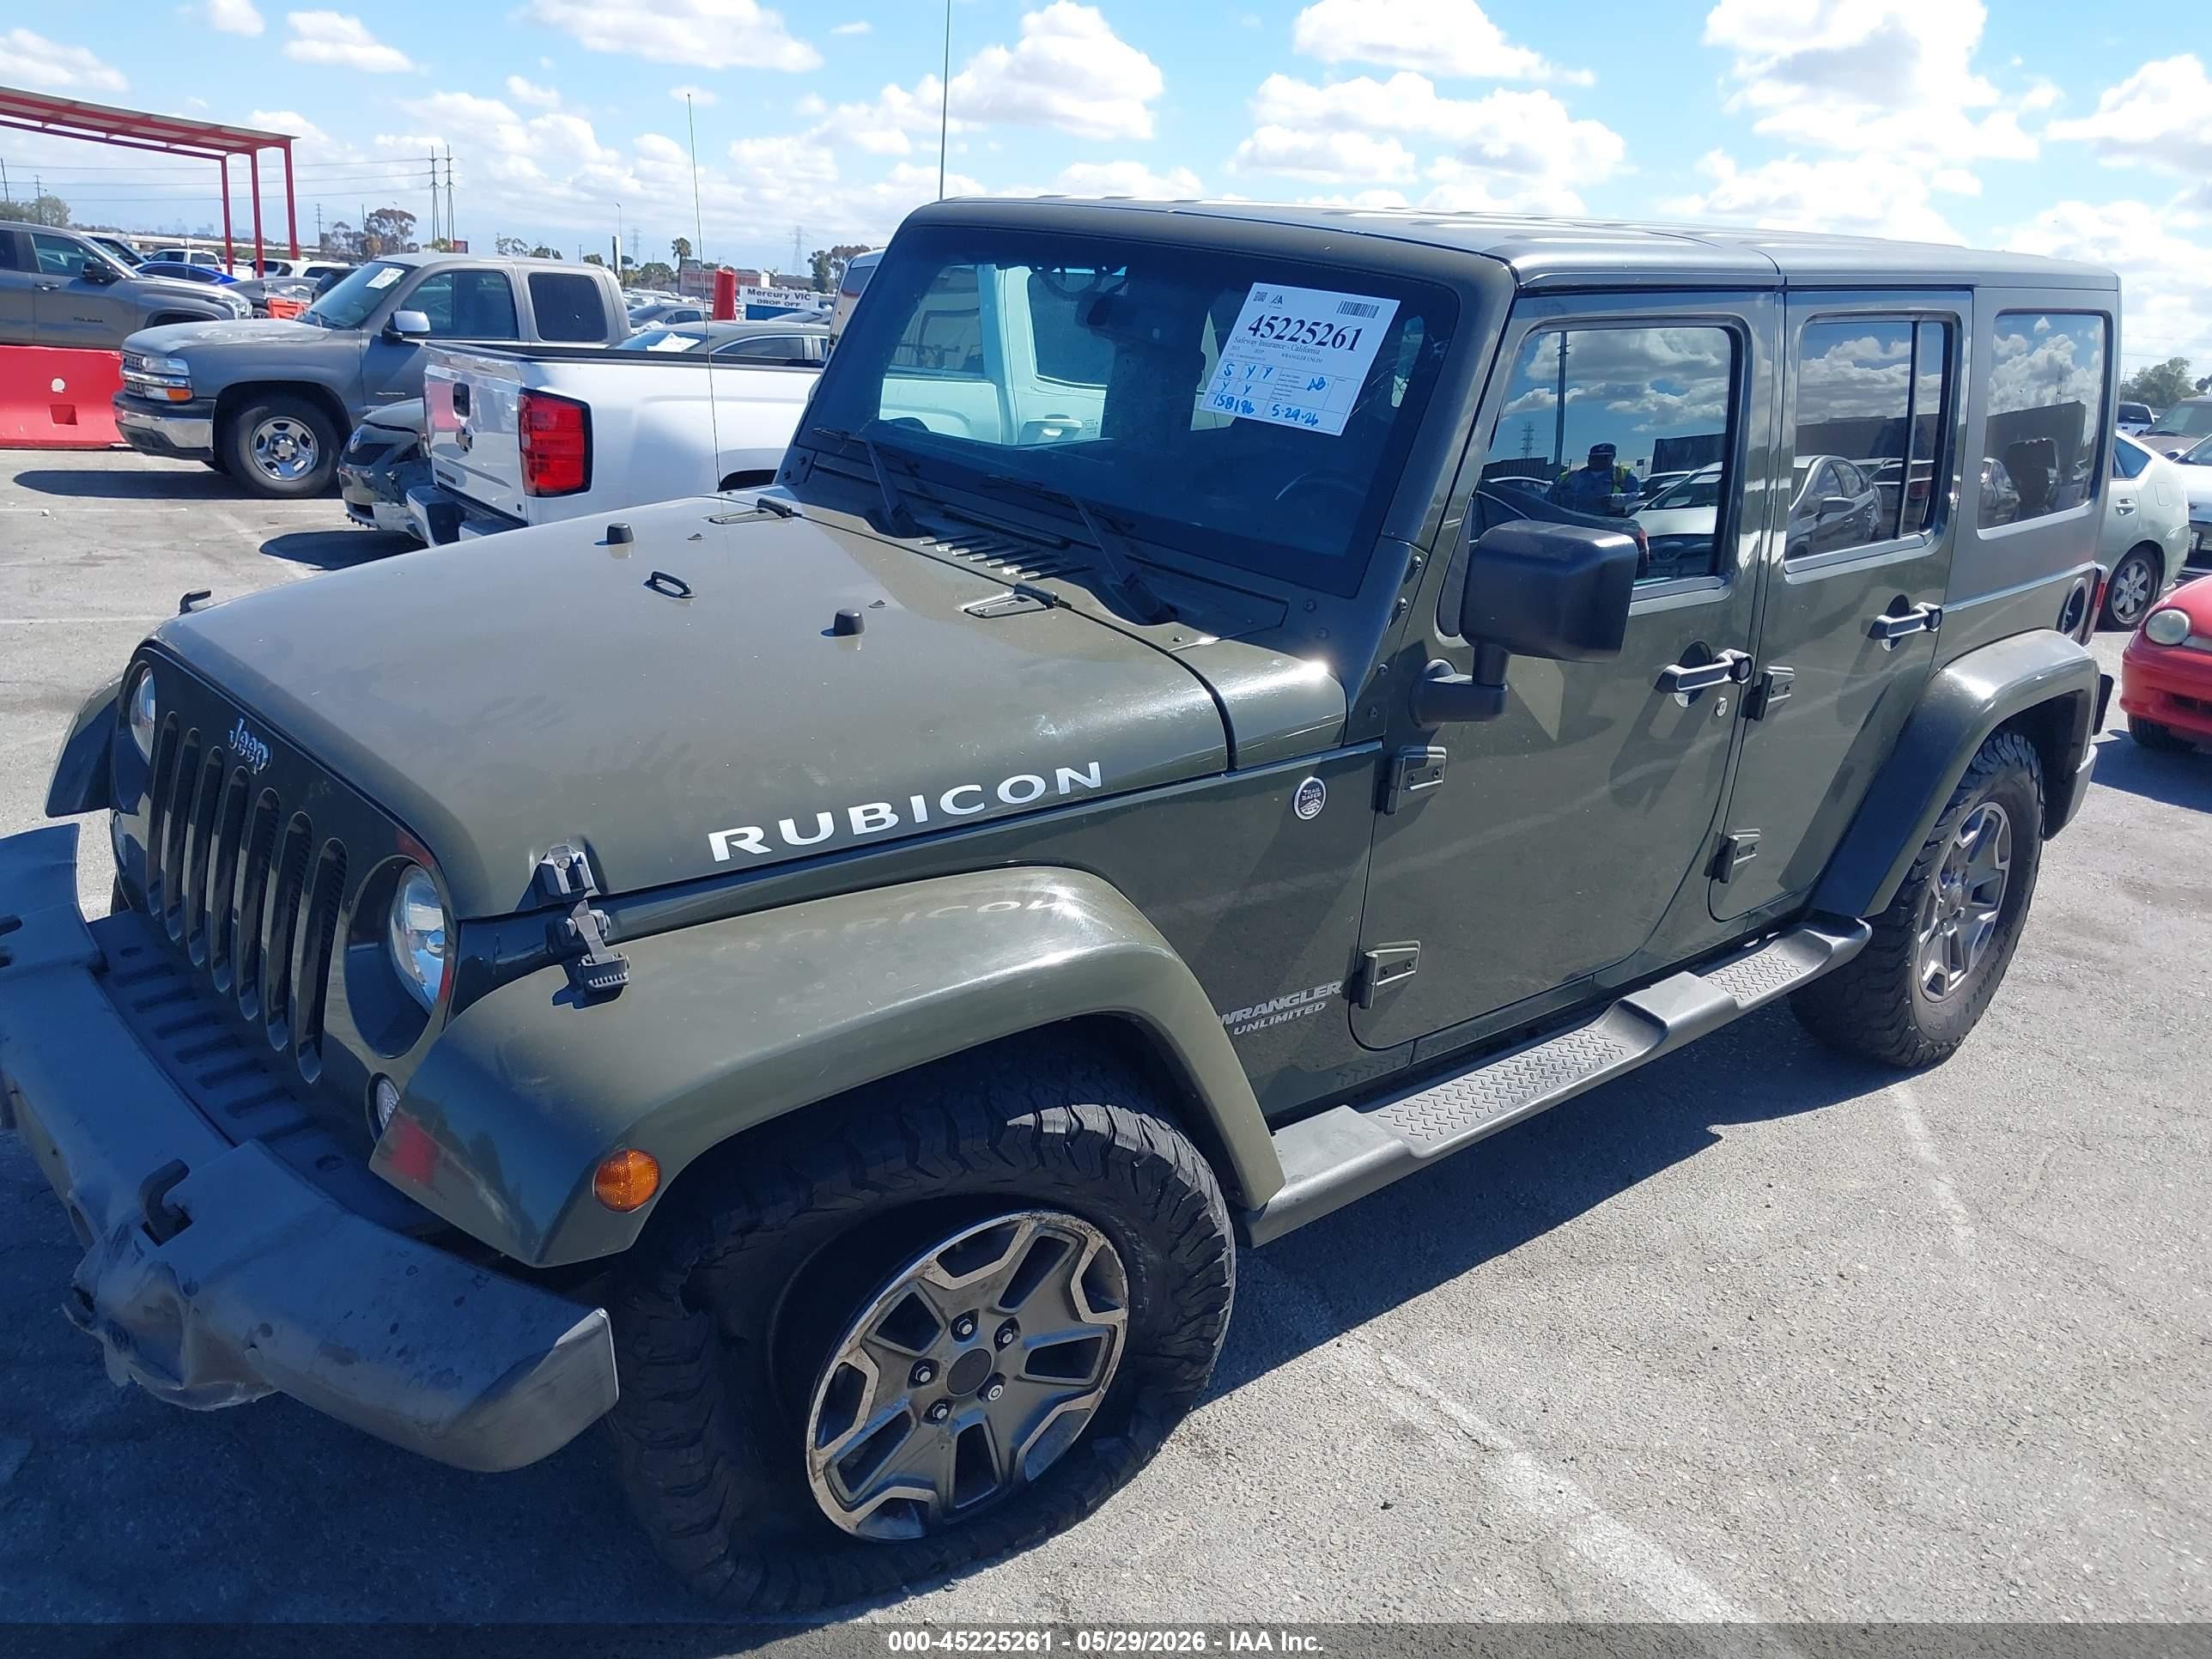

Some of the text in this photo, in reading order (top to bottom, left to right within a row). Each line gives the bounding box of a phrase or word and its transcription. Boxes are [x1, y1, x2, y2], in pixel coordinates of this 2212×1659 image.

[747, 289, 790, 301] Mercury
[1234, 336, 1257, 346] Safeway
[1259, 340, 1285, 350] Insurance
[1291, 343, 1321, 356] California
[1248, 313, 1364, 352] 45225261
[228, 718, 270, 775] Jeep
[708, 762, 1103, 861] RUBICON
[1302, 793, 1322, 801] RATED
[1221, 981, 1342, 1025] WRANGLER
[1234, 1001, 1327, 1036] UNLIMITED
